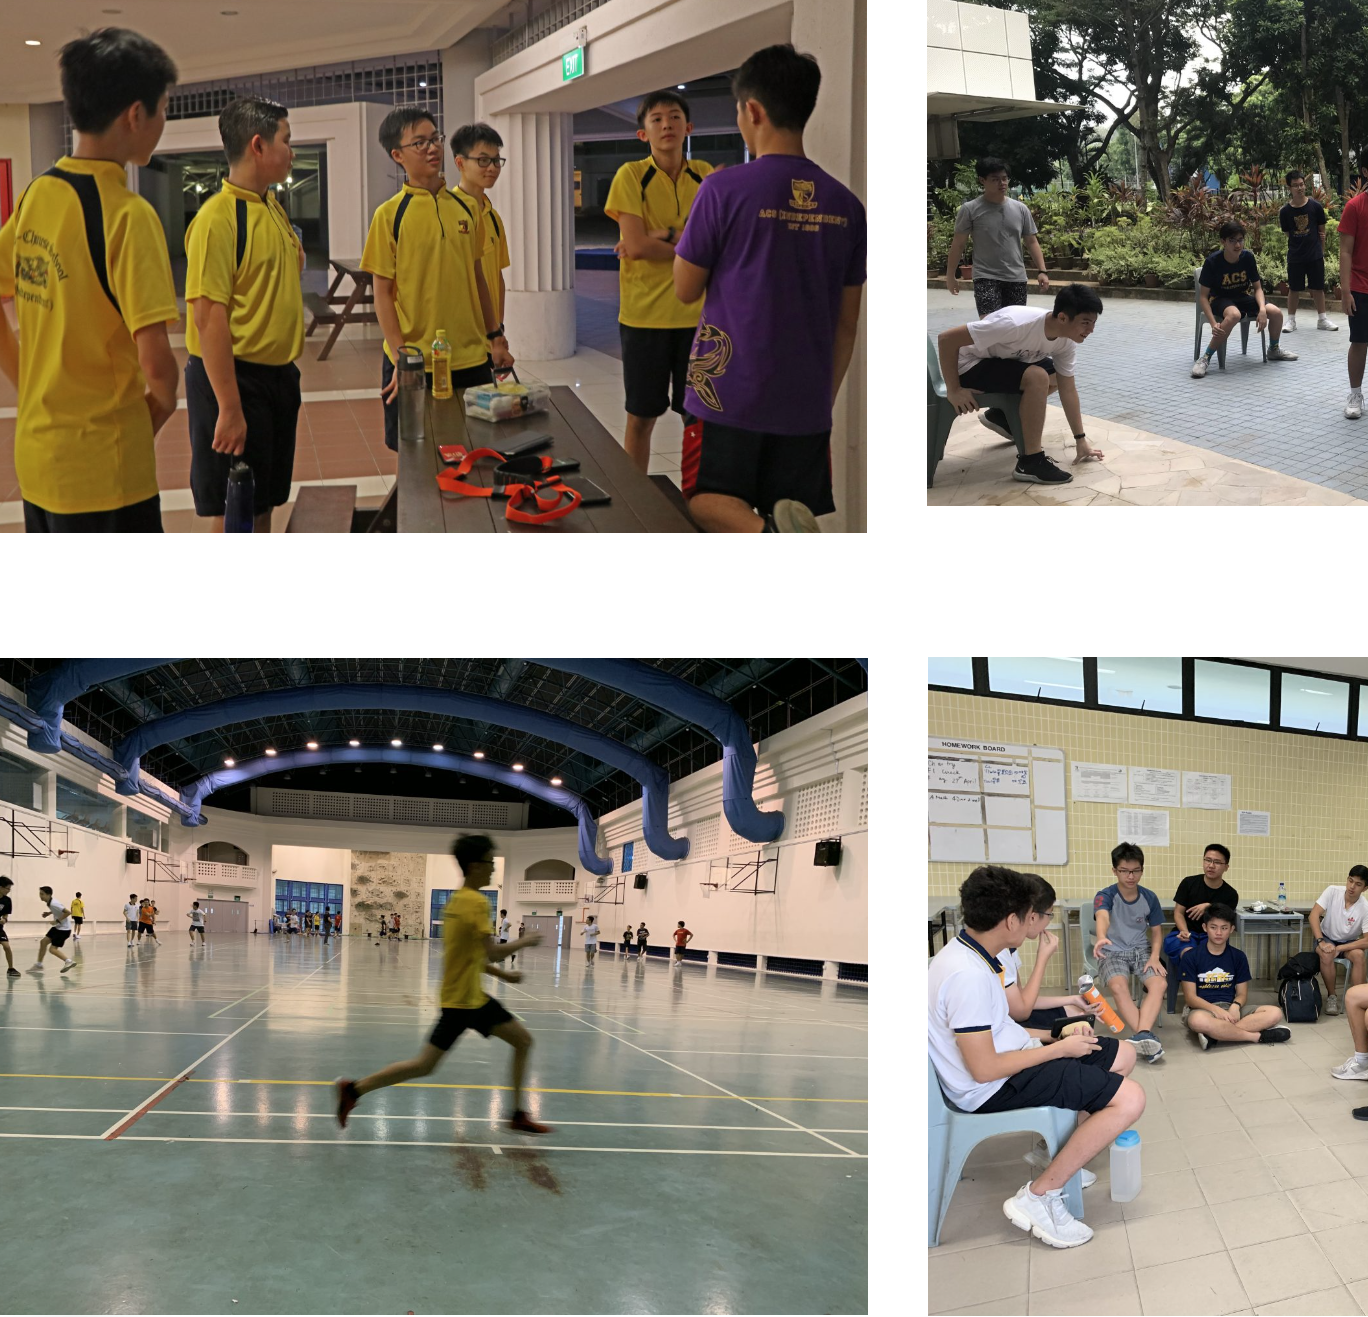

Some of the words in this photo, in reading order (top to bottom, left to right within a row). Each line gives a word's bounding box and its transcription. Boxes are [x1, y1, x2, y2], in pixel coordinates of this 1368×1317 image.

[565, 53, 578, 76] EXIT
[759, 209, 777, 218] ACS
[1221, 270, 1247, 286] ACS
[942, 742, 981, 750] HOMEWORK
